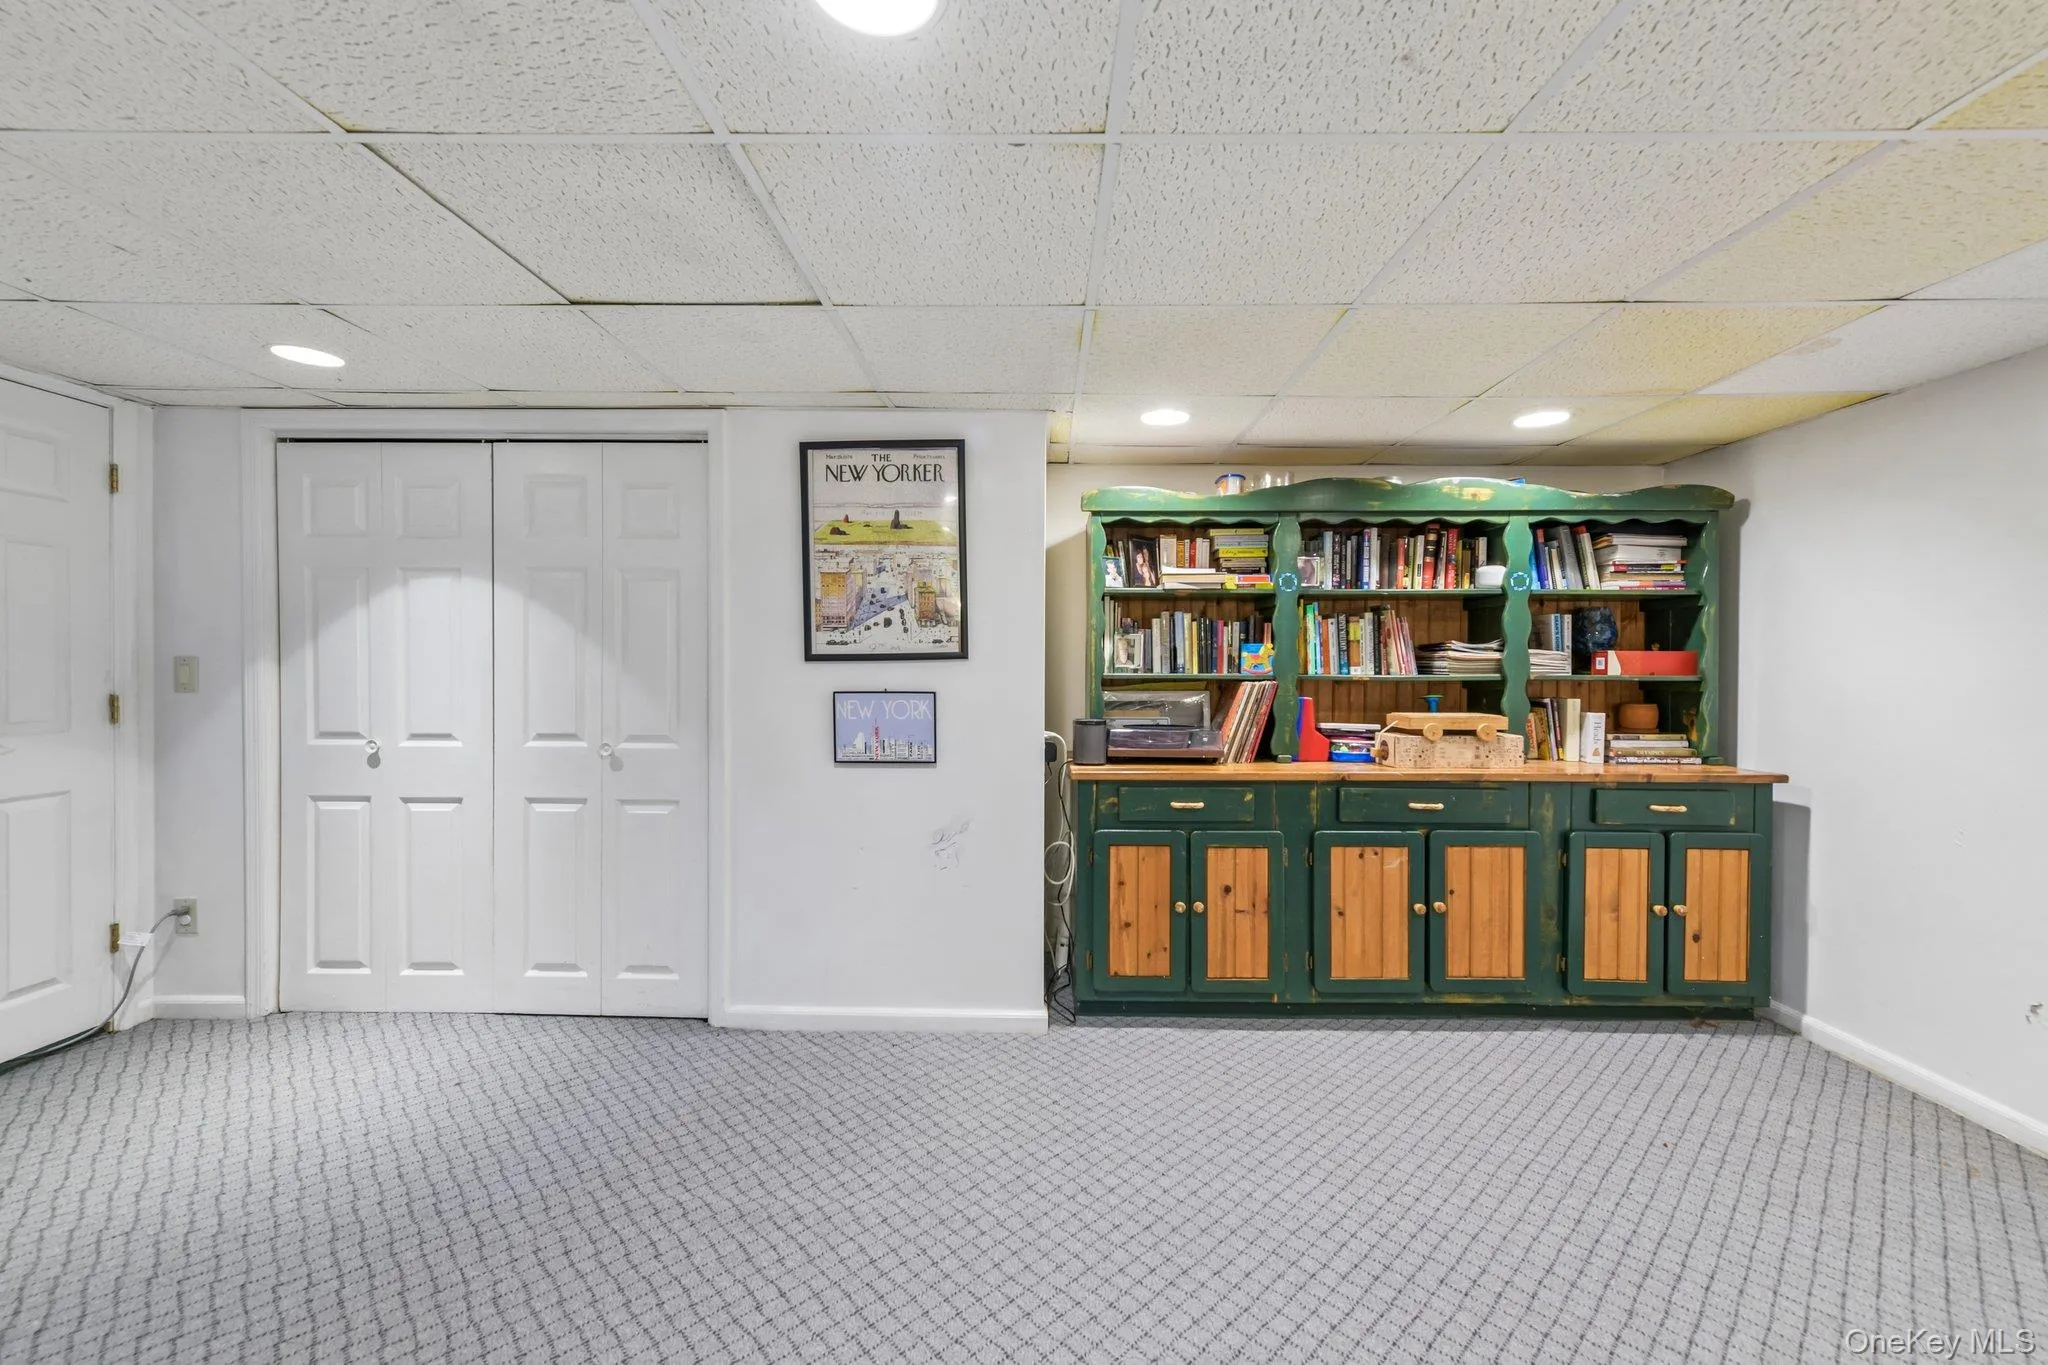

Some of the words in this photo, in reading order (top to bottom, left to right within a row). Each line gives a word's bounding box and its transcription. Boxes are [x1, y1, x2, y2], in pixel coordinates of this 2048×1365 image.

[871, 453, 892, 463] THE
[825, 464, 869, 483] NEW
[871, 463, 945, 483] YORKER
[836, 699, 874, 720] NEW
[882, 699, 933, 720] YORK
